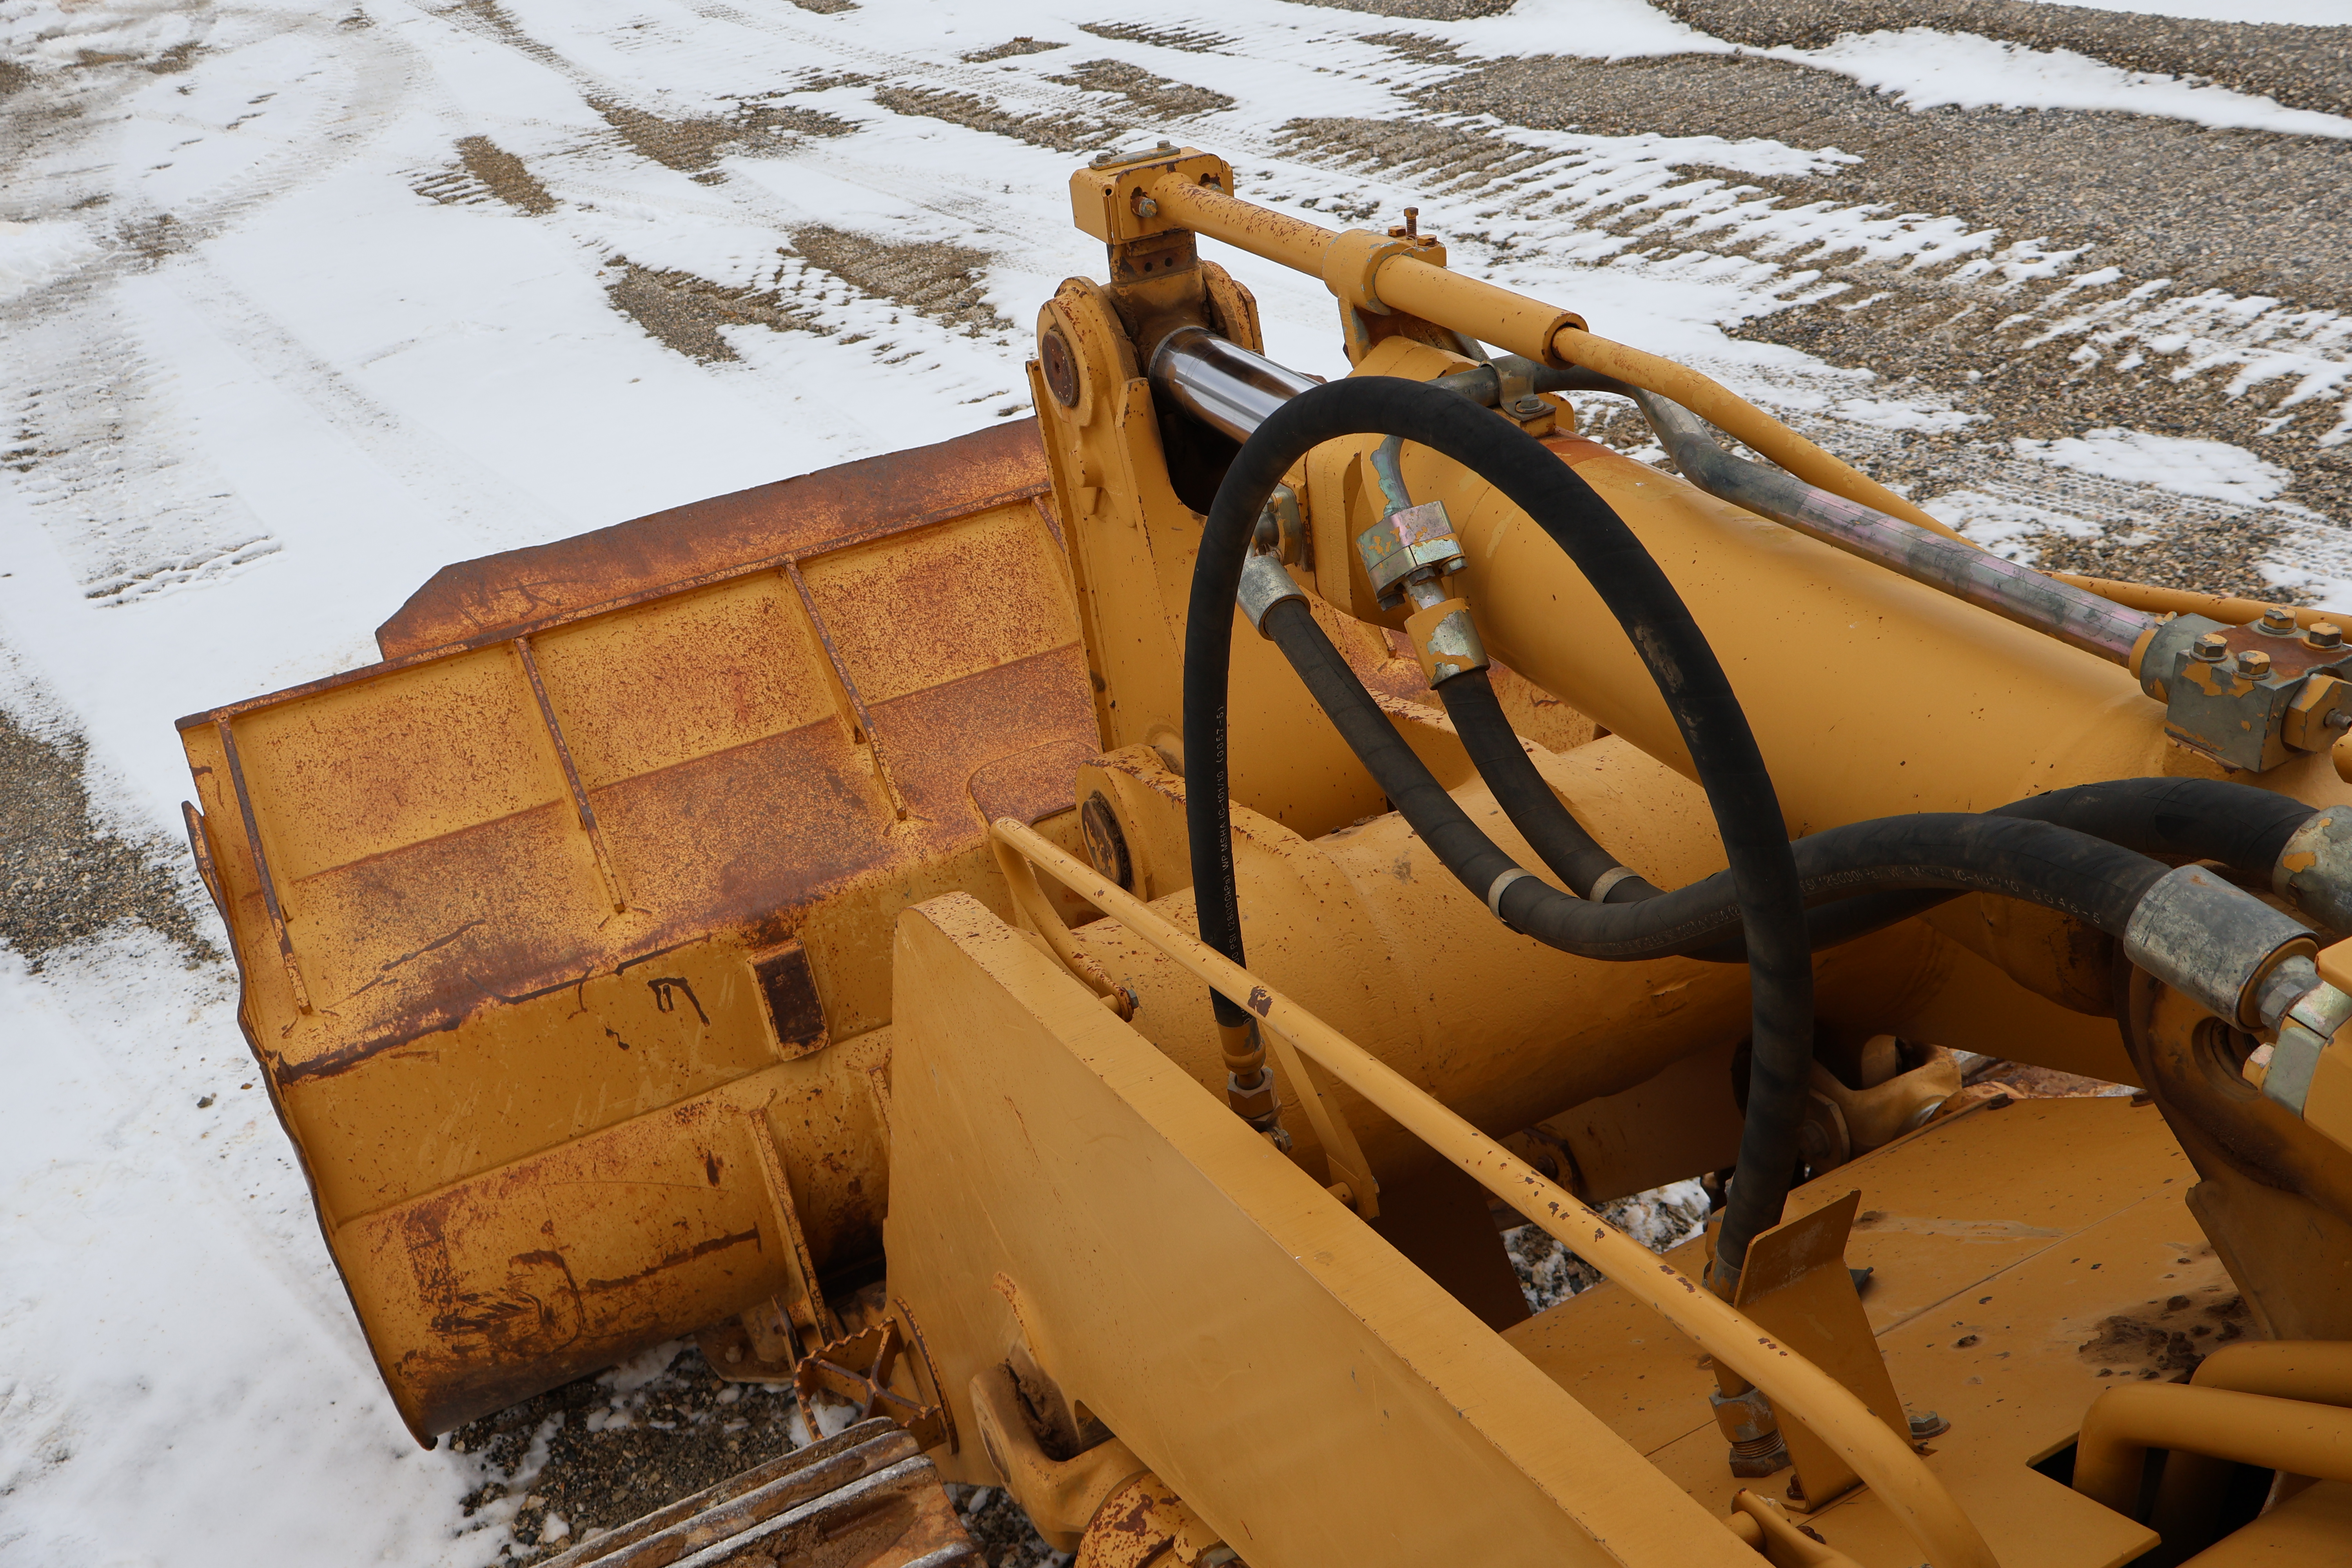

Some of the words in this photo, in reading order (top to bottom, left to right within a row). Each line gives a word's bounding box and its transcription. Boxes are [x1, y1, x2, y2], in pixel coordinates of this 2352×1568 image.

[1220, 821, 1228, 852] MSHA
[1221, 855, 1230, 871] WP
[1229, 933, 1238, 950] PSI
